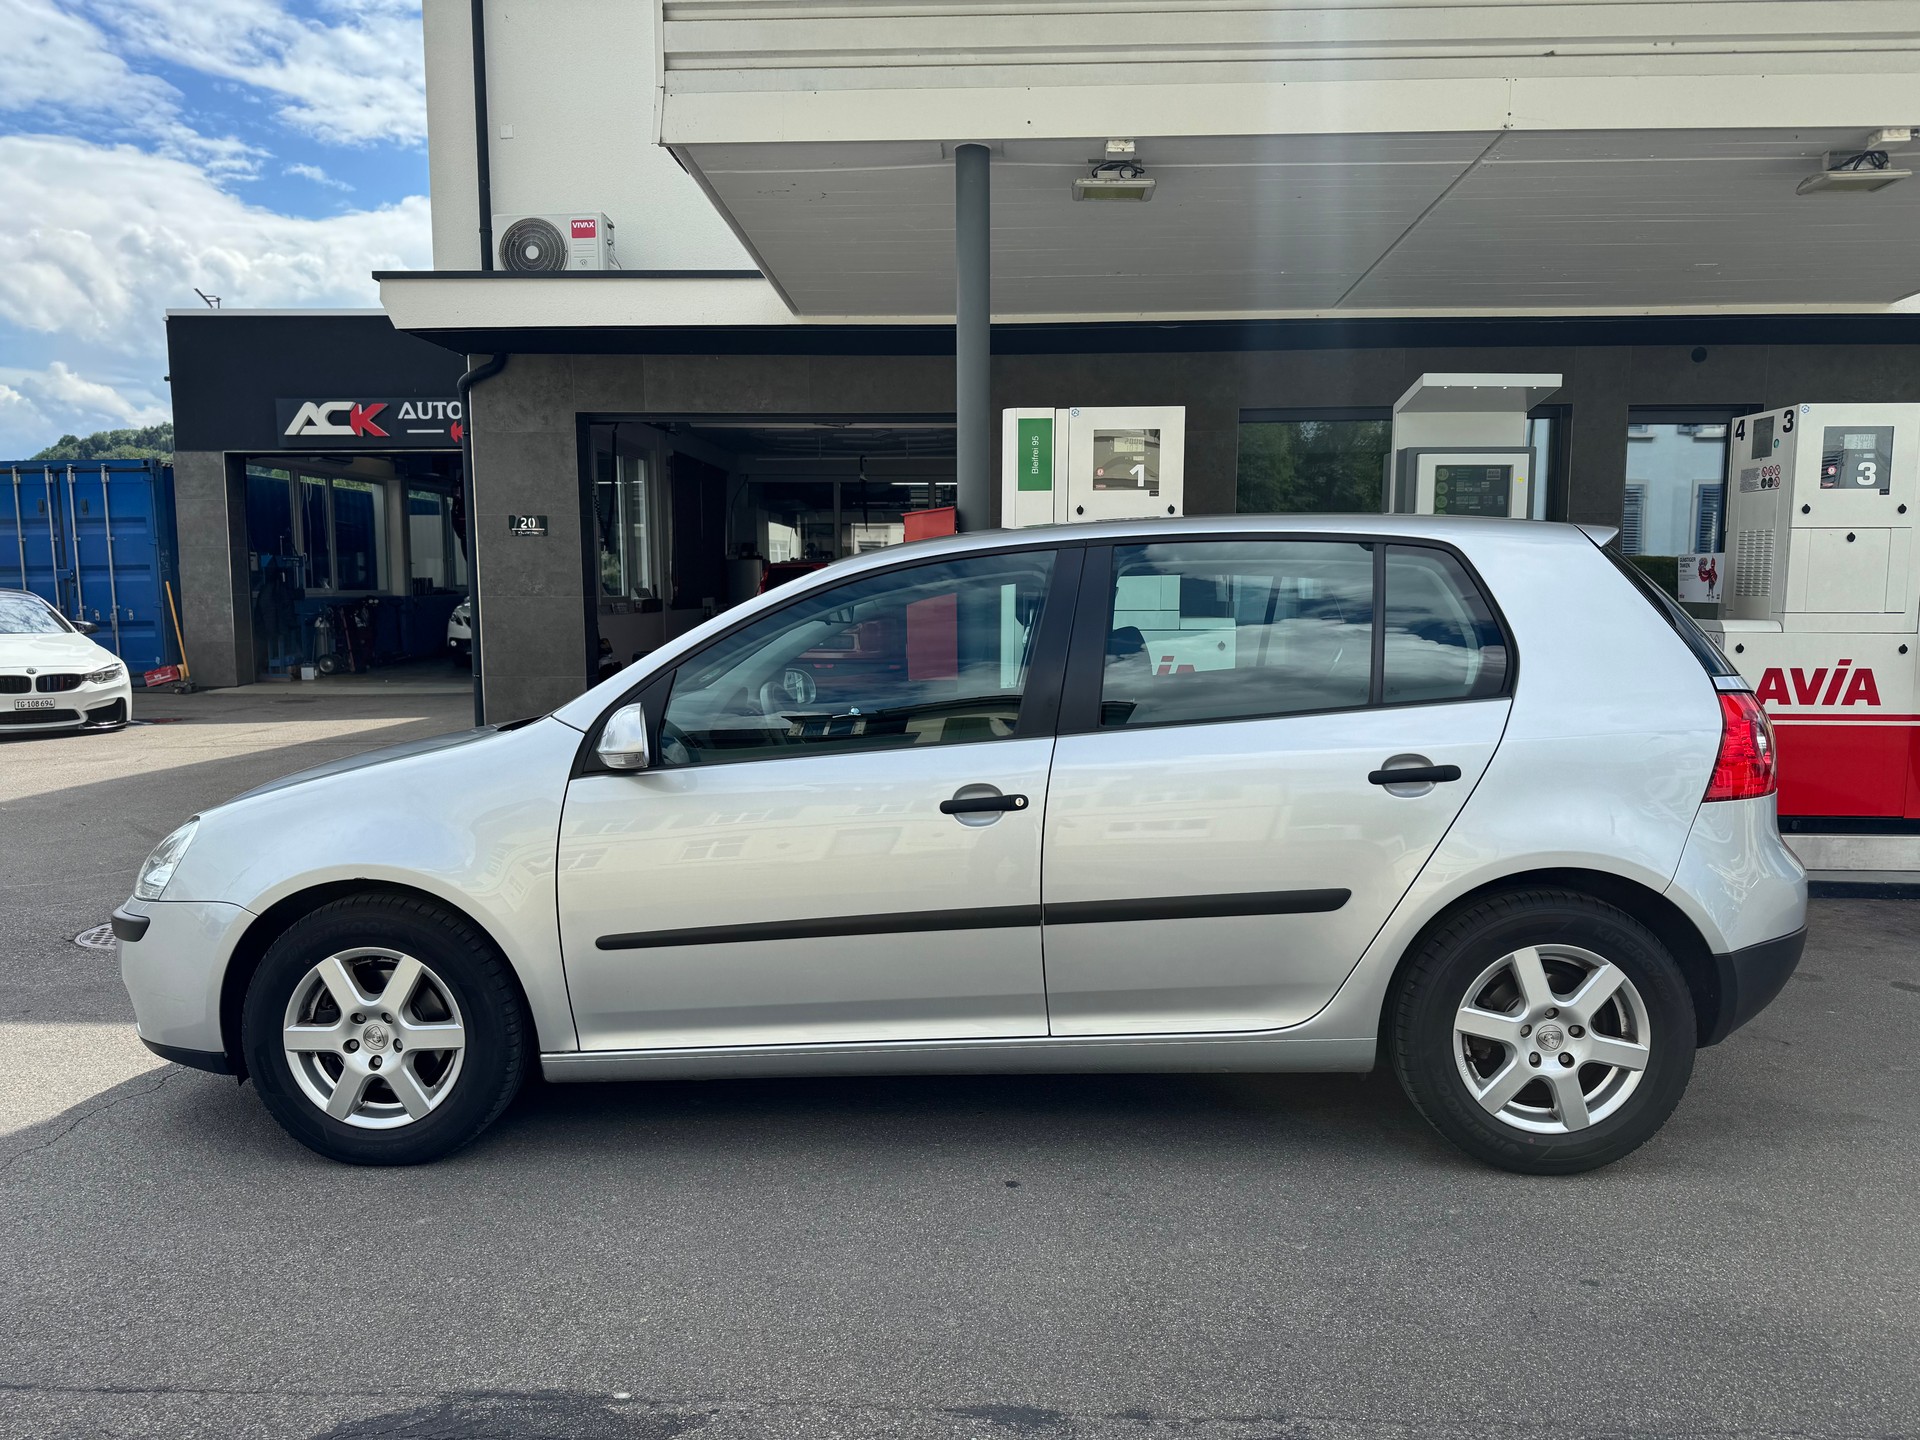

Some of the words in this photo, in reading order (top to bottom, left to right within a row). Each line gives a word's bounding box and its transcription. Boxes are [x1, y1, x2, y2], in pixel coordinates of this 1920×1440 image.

[284, 401, 390, 437] ACK
[1735, 419, 1745, 441] 4
[1782, 409, 1795, 433] 3
[1031, 435, 1039, 446] 95
[1031, 447, 1039, 474] Bleifrei
[1129, 464, 1145, 487] 1
[1856, 461, 1877, 486] 3
[520, 517, 536, 529] 20
